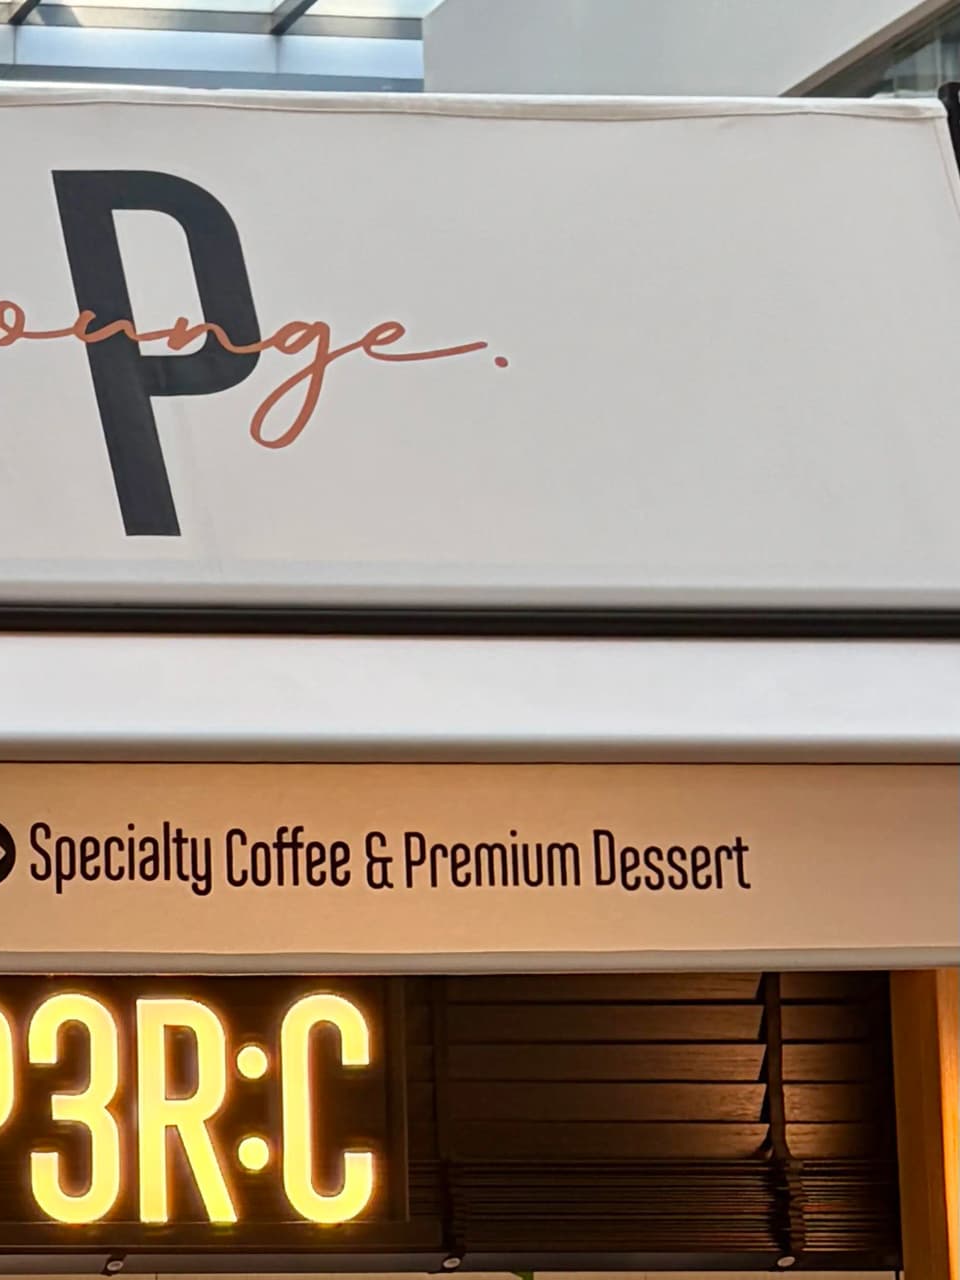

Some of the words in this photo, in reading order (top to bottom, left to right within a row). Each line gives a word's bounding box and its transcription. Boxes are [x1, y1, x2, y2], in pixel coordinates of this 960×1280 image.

[51, 169, 261, 537] P
[30, 821, 212, 896] Specialty
[226, 825, 351, 888] Coffee
[365, 831, 394, 890] &
[405, 829, 581, 889] Premium
[593, 829, 751, 891] Dessert
